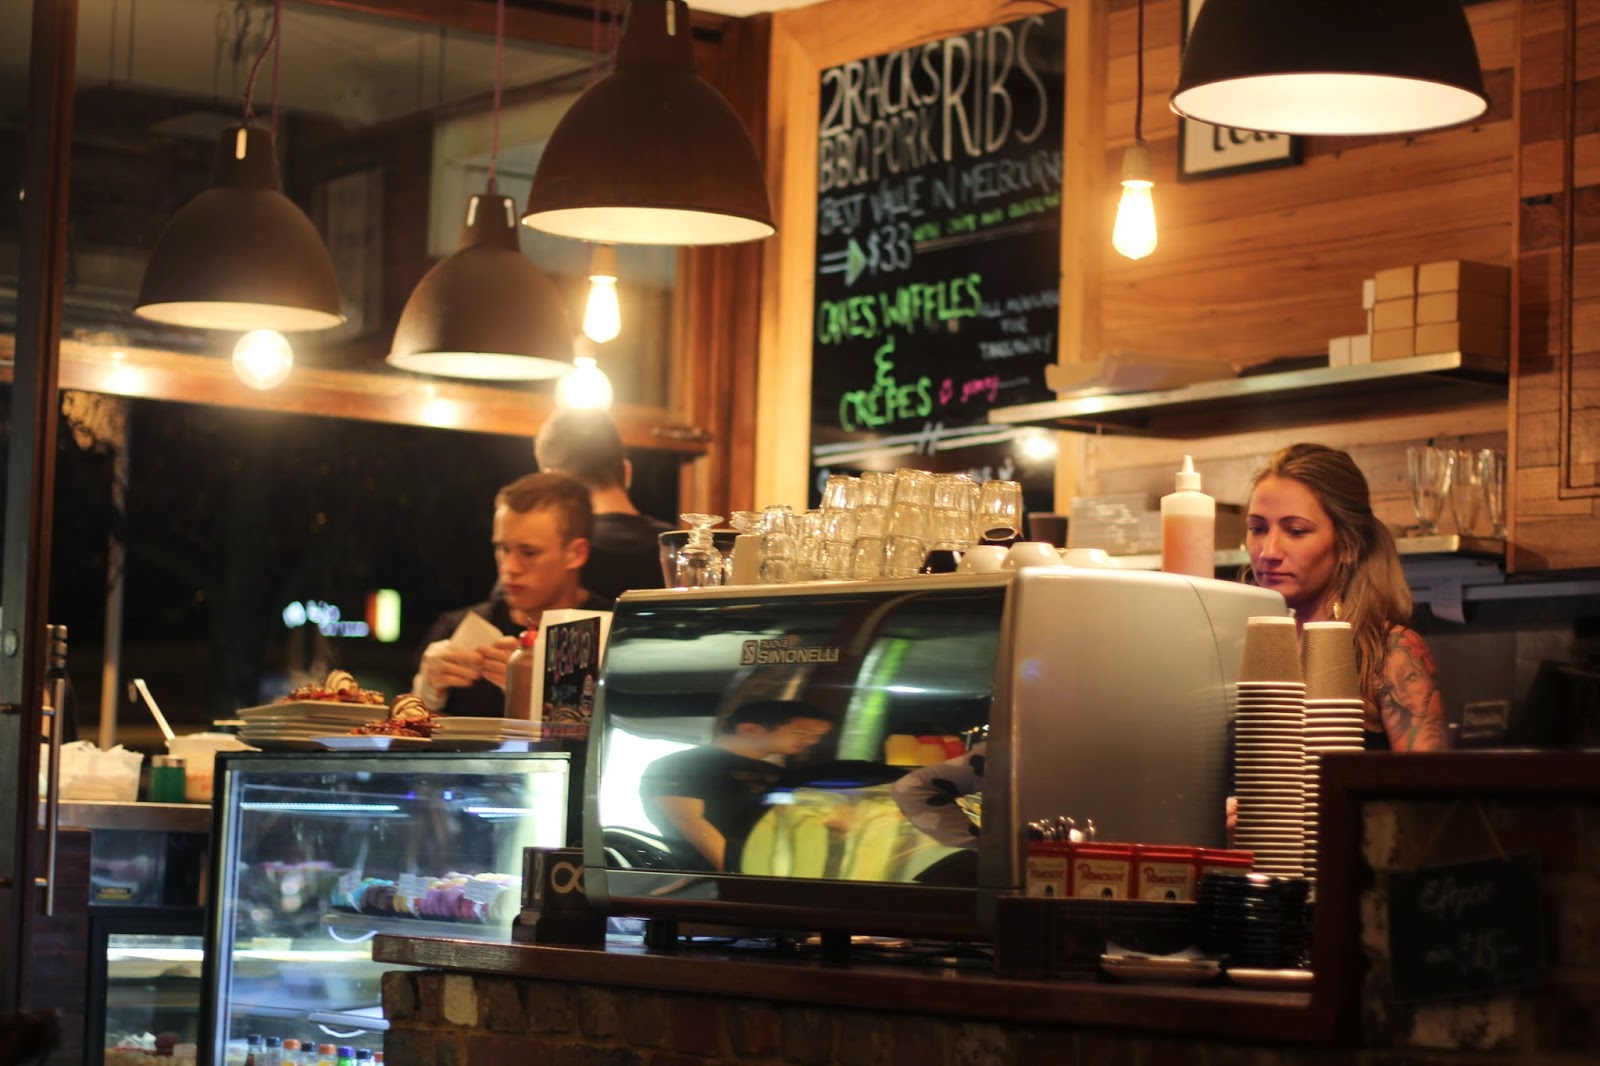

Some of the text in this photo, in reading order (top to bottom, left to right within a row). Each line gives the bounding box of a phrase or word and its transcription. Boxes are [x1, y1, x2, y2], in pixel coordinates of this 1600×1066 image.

[943, 15, 1048, 162] RIBS
[871, 105, 939, 181] PORK
[867, 221, 912, 277] $33
[757, 647, 840, 665] SIMONELLI
